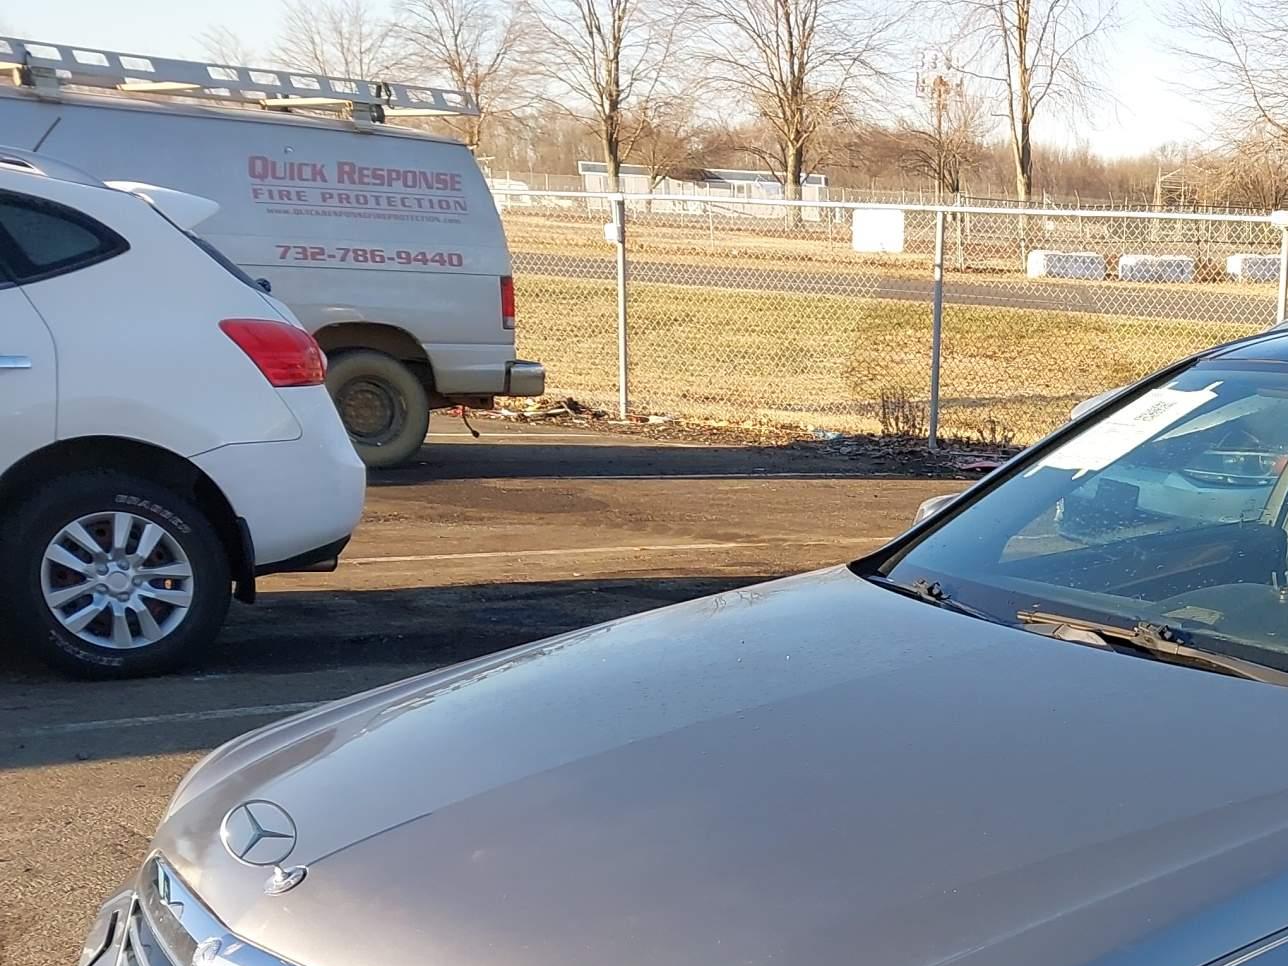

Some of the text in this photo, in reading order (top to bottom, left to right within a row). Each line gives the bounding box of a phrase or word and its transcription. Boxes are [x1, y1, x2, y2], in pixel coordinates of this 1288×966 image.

[248, 156, 463, 191] QUICK RESPONSE
[252, 187, 468, 212] FIRE PROTECTION
[275, 245, 464, 267] 732-786-9440
